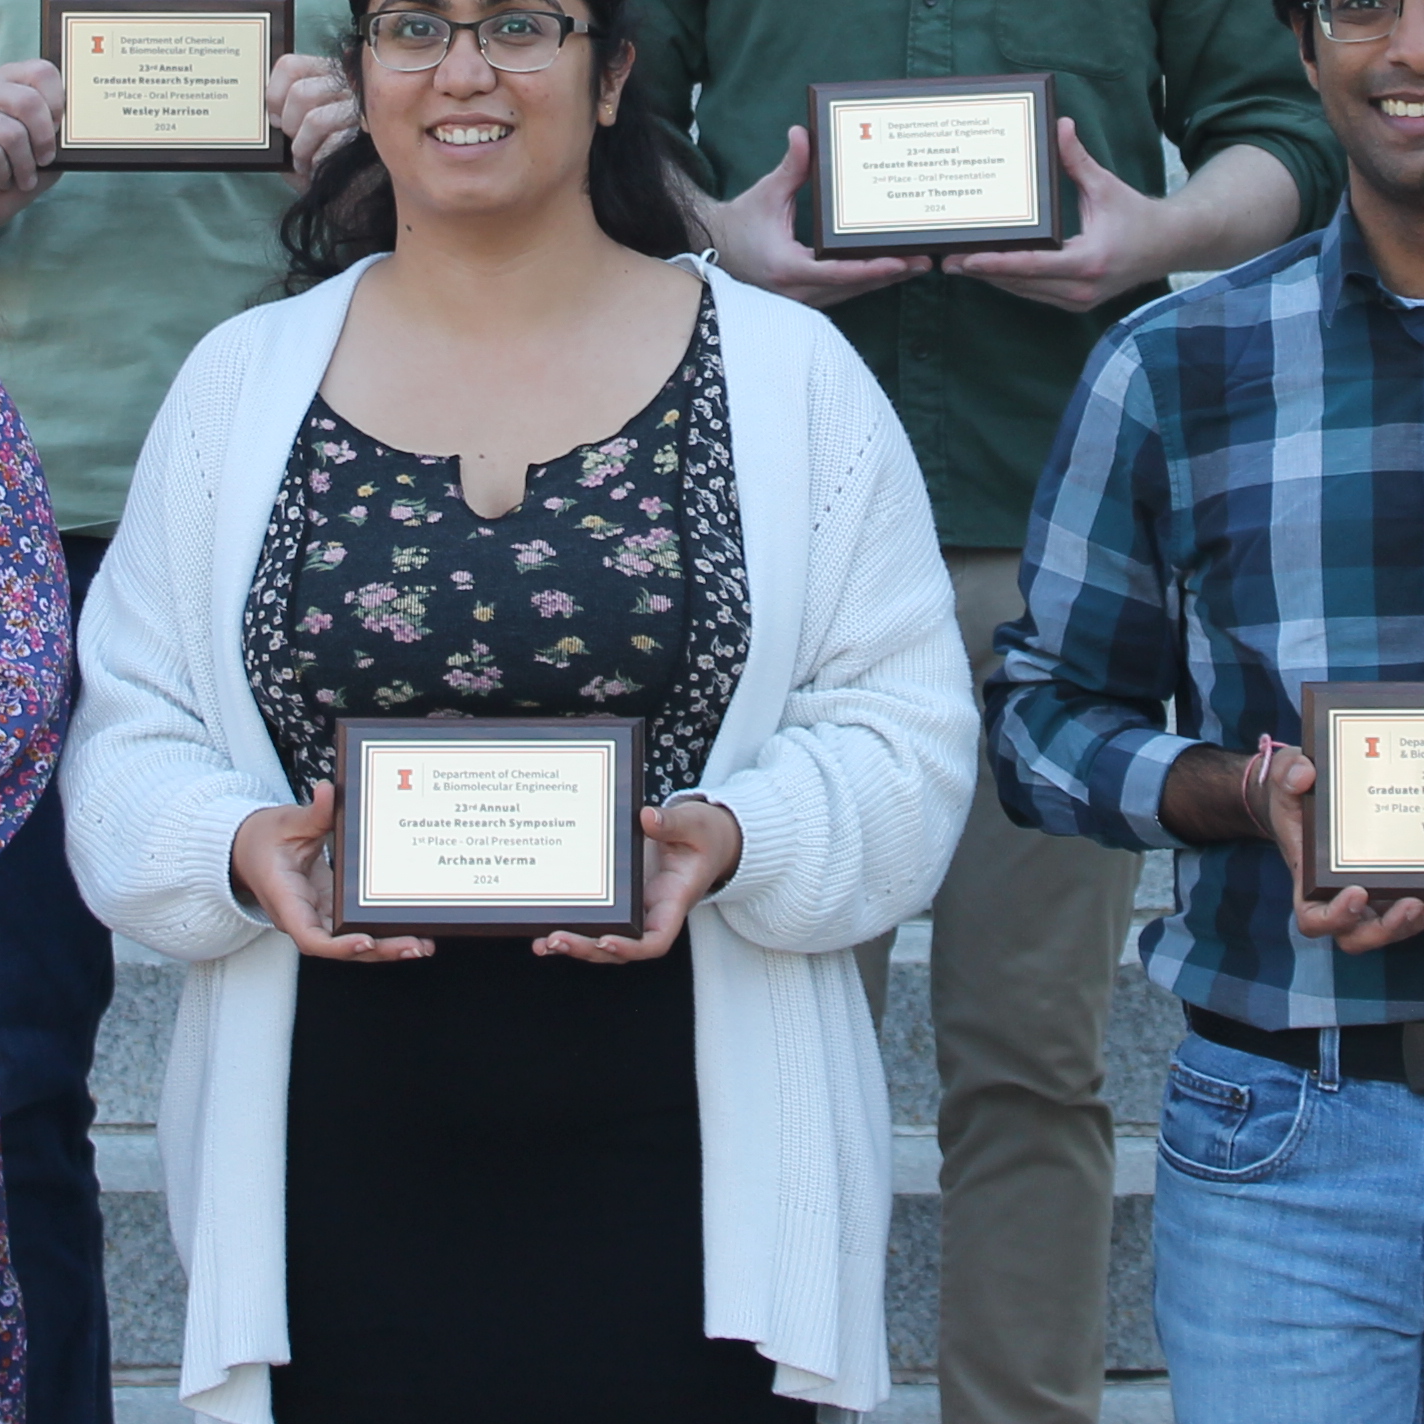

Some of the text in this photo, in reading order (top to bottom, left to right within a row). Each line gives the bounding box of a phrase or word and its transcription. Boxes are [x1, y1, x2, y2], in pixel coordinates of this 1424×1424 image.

[120, 36, 225, 46] Department of Chemical
[129, 47, 186, 55] Biomolecular
[188, 47, 240, 57] Engineering
[159, 64, 193, 72] Annual
[93, 76, 239, 88] Graduate Research Symposium
[118, 91, 142, 100] Place
[149, 91, 168, 100] Oral
[170, 91, 228, 100] Presentation
[122, 106, 209, 118] Wesley Harrison
[155, 123, 176, 131] 2024
[888, 118, 989, 131] Department of Chemical
[897, 130, 953, 139] Biomolecular
[955, 127, 1005, 139] Engineering
[927, 146, 960, 155] Annual
[863, 156, 1005, 170] Graduate Research Symposium
[888, 175, 912, 183] Place
[919, 173, 937, 182] Oral
[939, 172, 996, 181] Presentation
[887, 187, 983, 199] Gunnar Thompson
[925, 204, 946, 213] 2024
[1400, 750, 1408, 758] &
[433, 769, 559, 781] Department of Chemical
[433, 782, 578, 793] & Biomolecular Engineering
[1368, 785, 1419, 795] Graduate
[479, 803, 520, 813] Annual
[1391, 803, 1421, 813] Place
[399, 818, 576, 831] Graduate Research Symposium
[427, 836, 457, 846] Place
[466, 836, 489, 846] Oral
[492, 836, 562, 846] Presentation
[438, 855, 536, 866] Archana Verma
[473, 875, 499, 885] 2024
